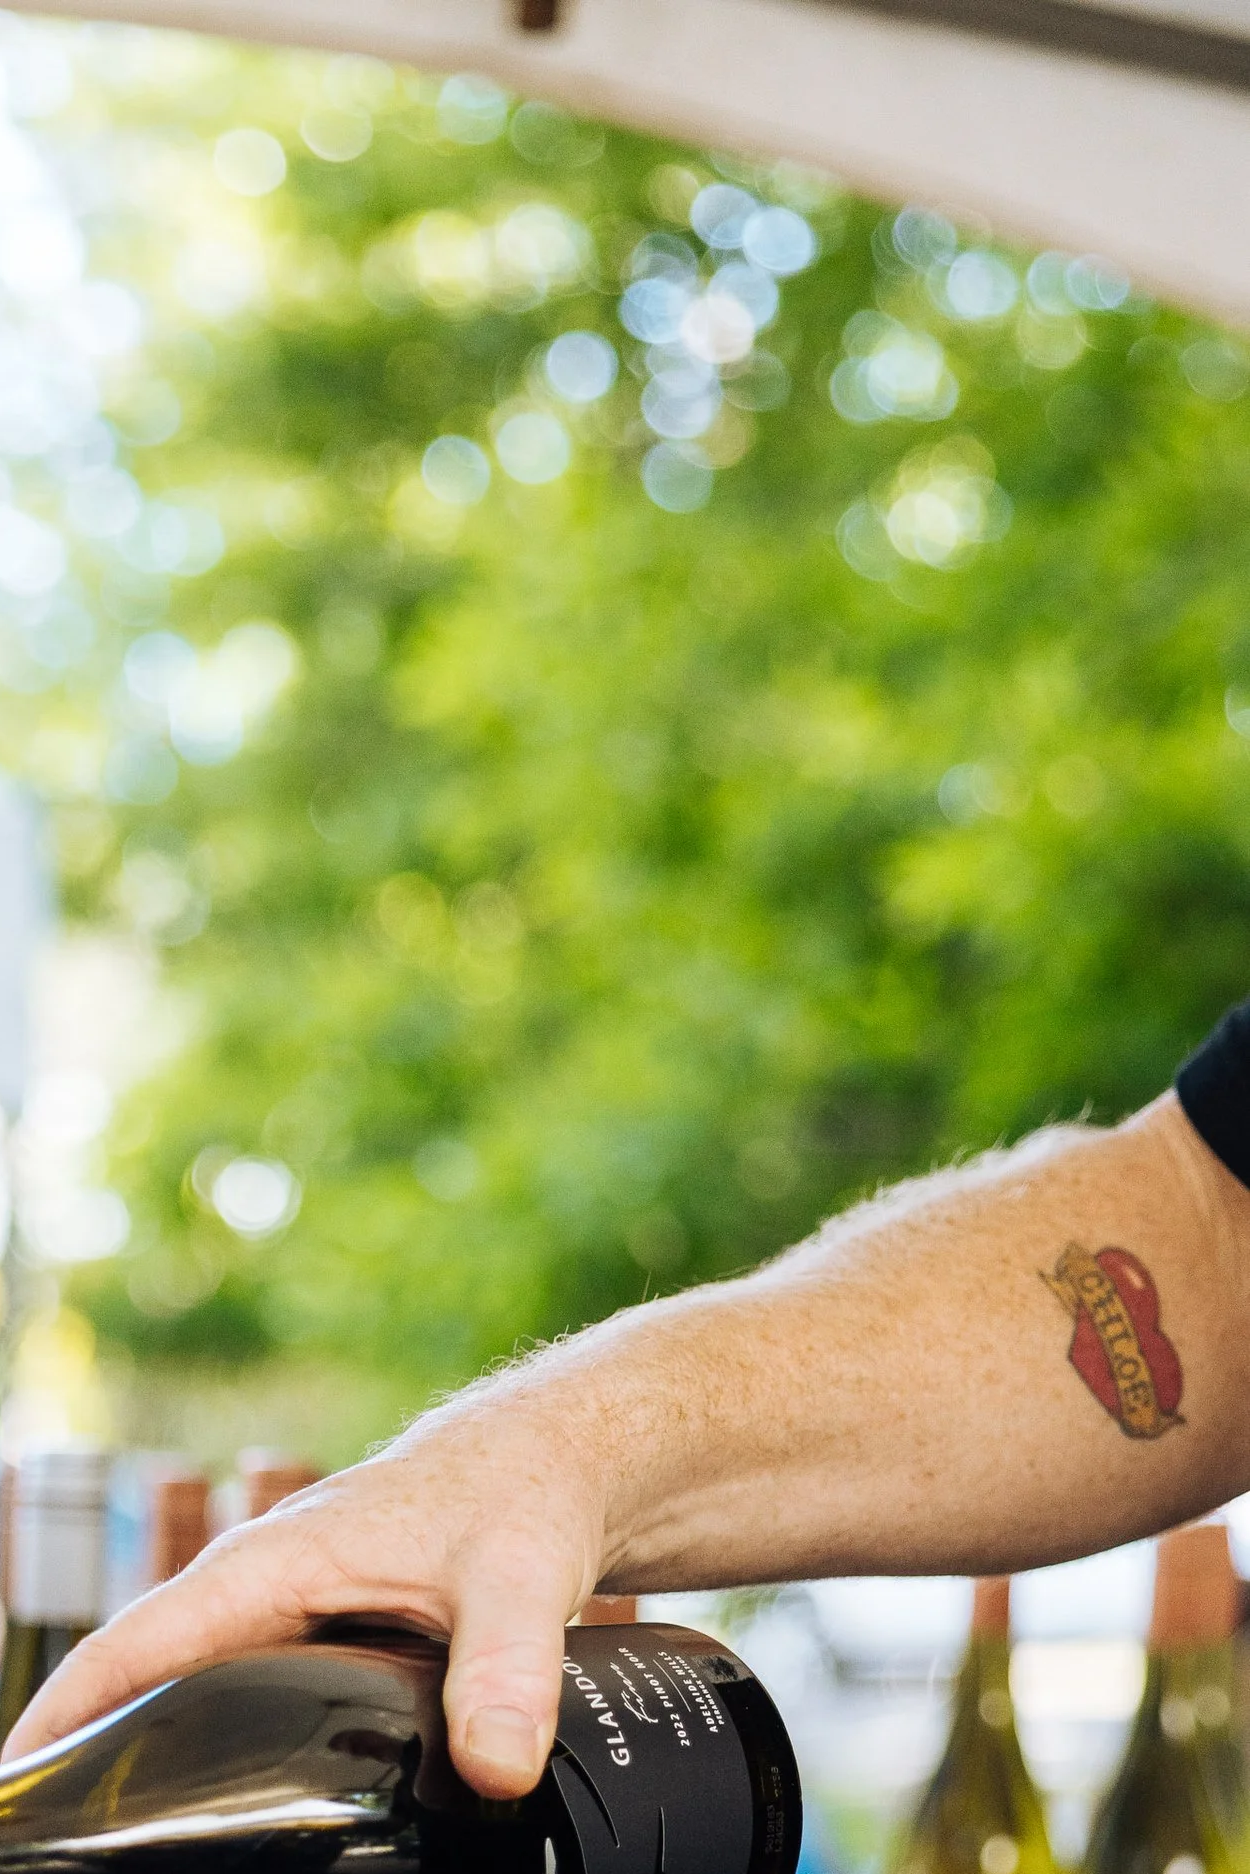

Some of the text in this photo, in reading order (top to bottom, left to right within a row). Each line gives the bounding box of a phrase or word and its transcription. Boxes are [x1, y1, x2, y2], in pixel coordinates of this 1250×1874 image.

[562, 1656, 631, 1766] GLANDO
[617, 1647, 691, 1747] 2022 PINOT NOIR
[657, 1651, 719, 1733] ADELAIDE HILLS
[674, 1655, 725, 1725] PERAMANGK NATION
